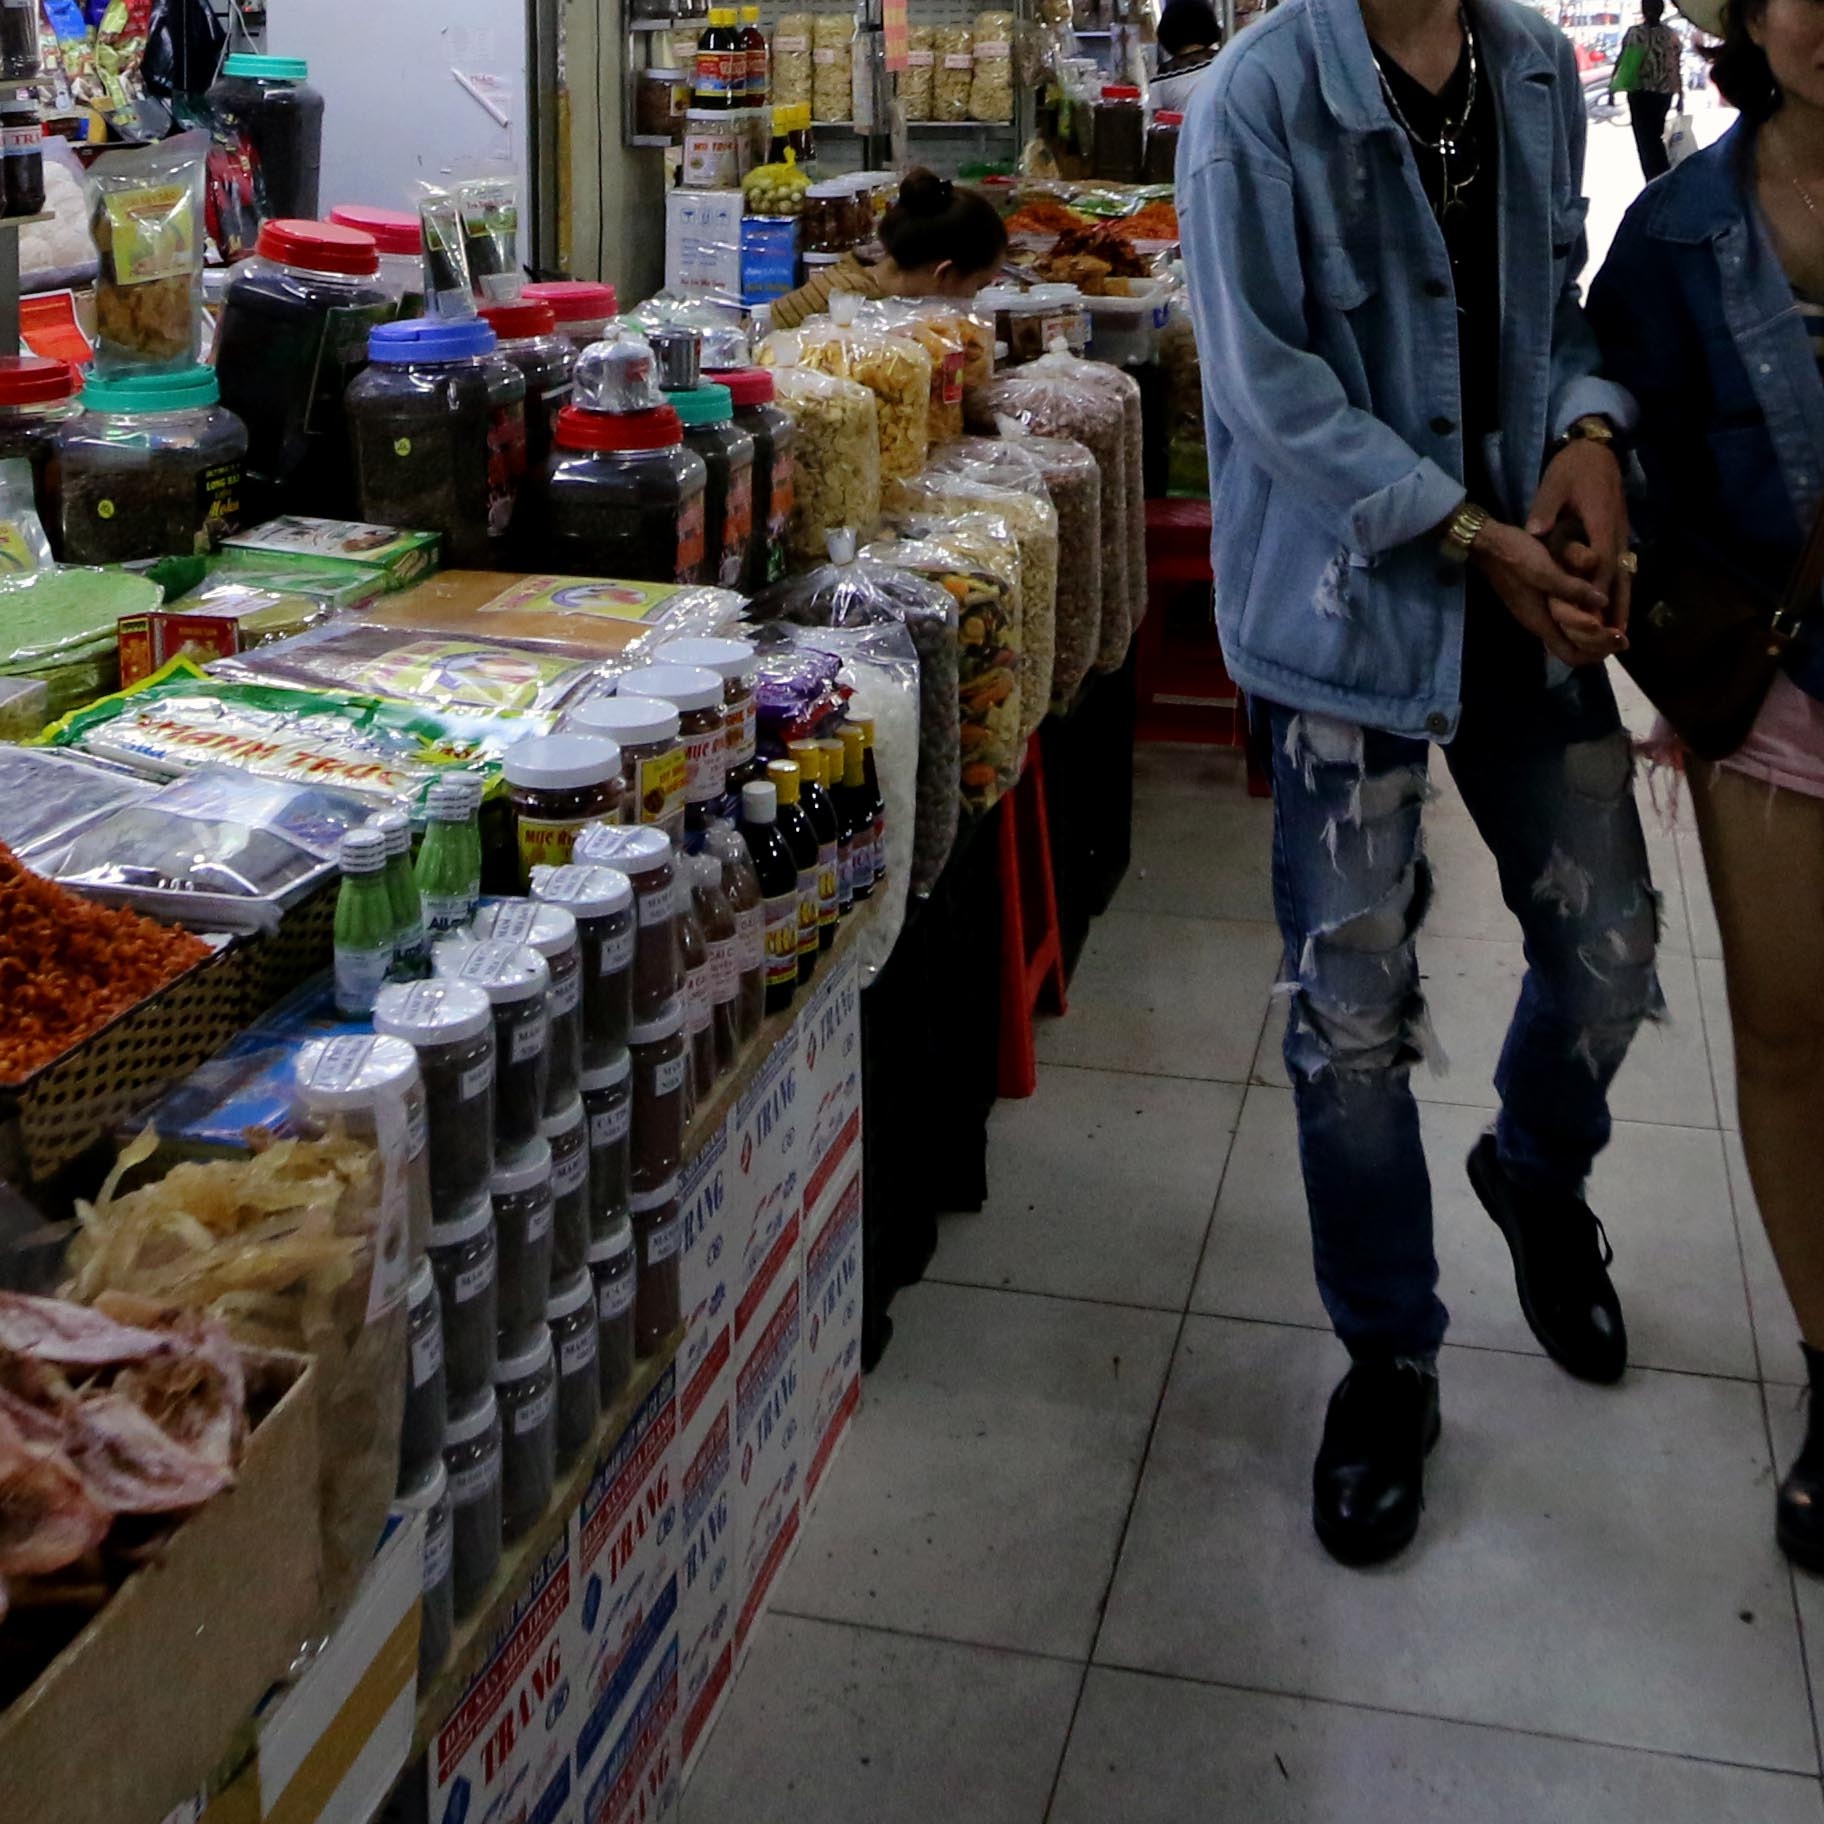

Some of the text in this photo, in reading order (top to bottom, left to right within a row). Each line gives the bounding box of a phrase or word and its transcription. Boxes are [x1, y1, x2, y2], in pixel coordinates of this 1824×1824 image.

[684, 1169, 725, 1255] RANG
[608, 1463, 670, 1585] TRANG
[686, 1490, 729, 1590] RANG
[480, 1636, 562, 1786] TRANG
